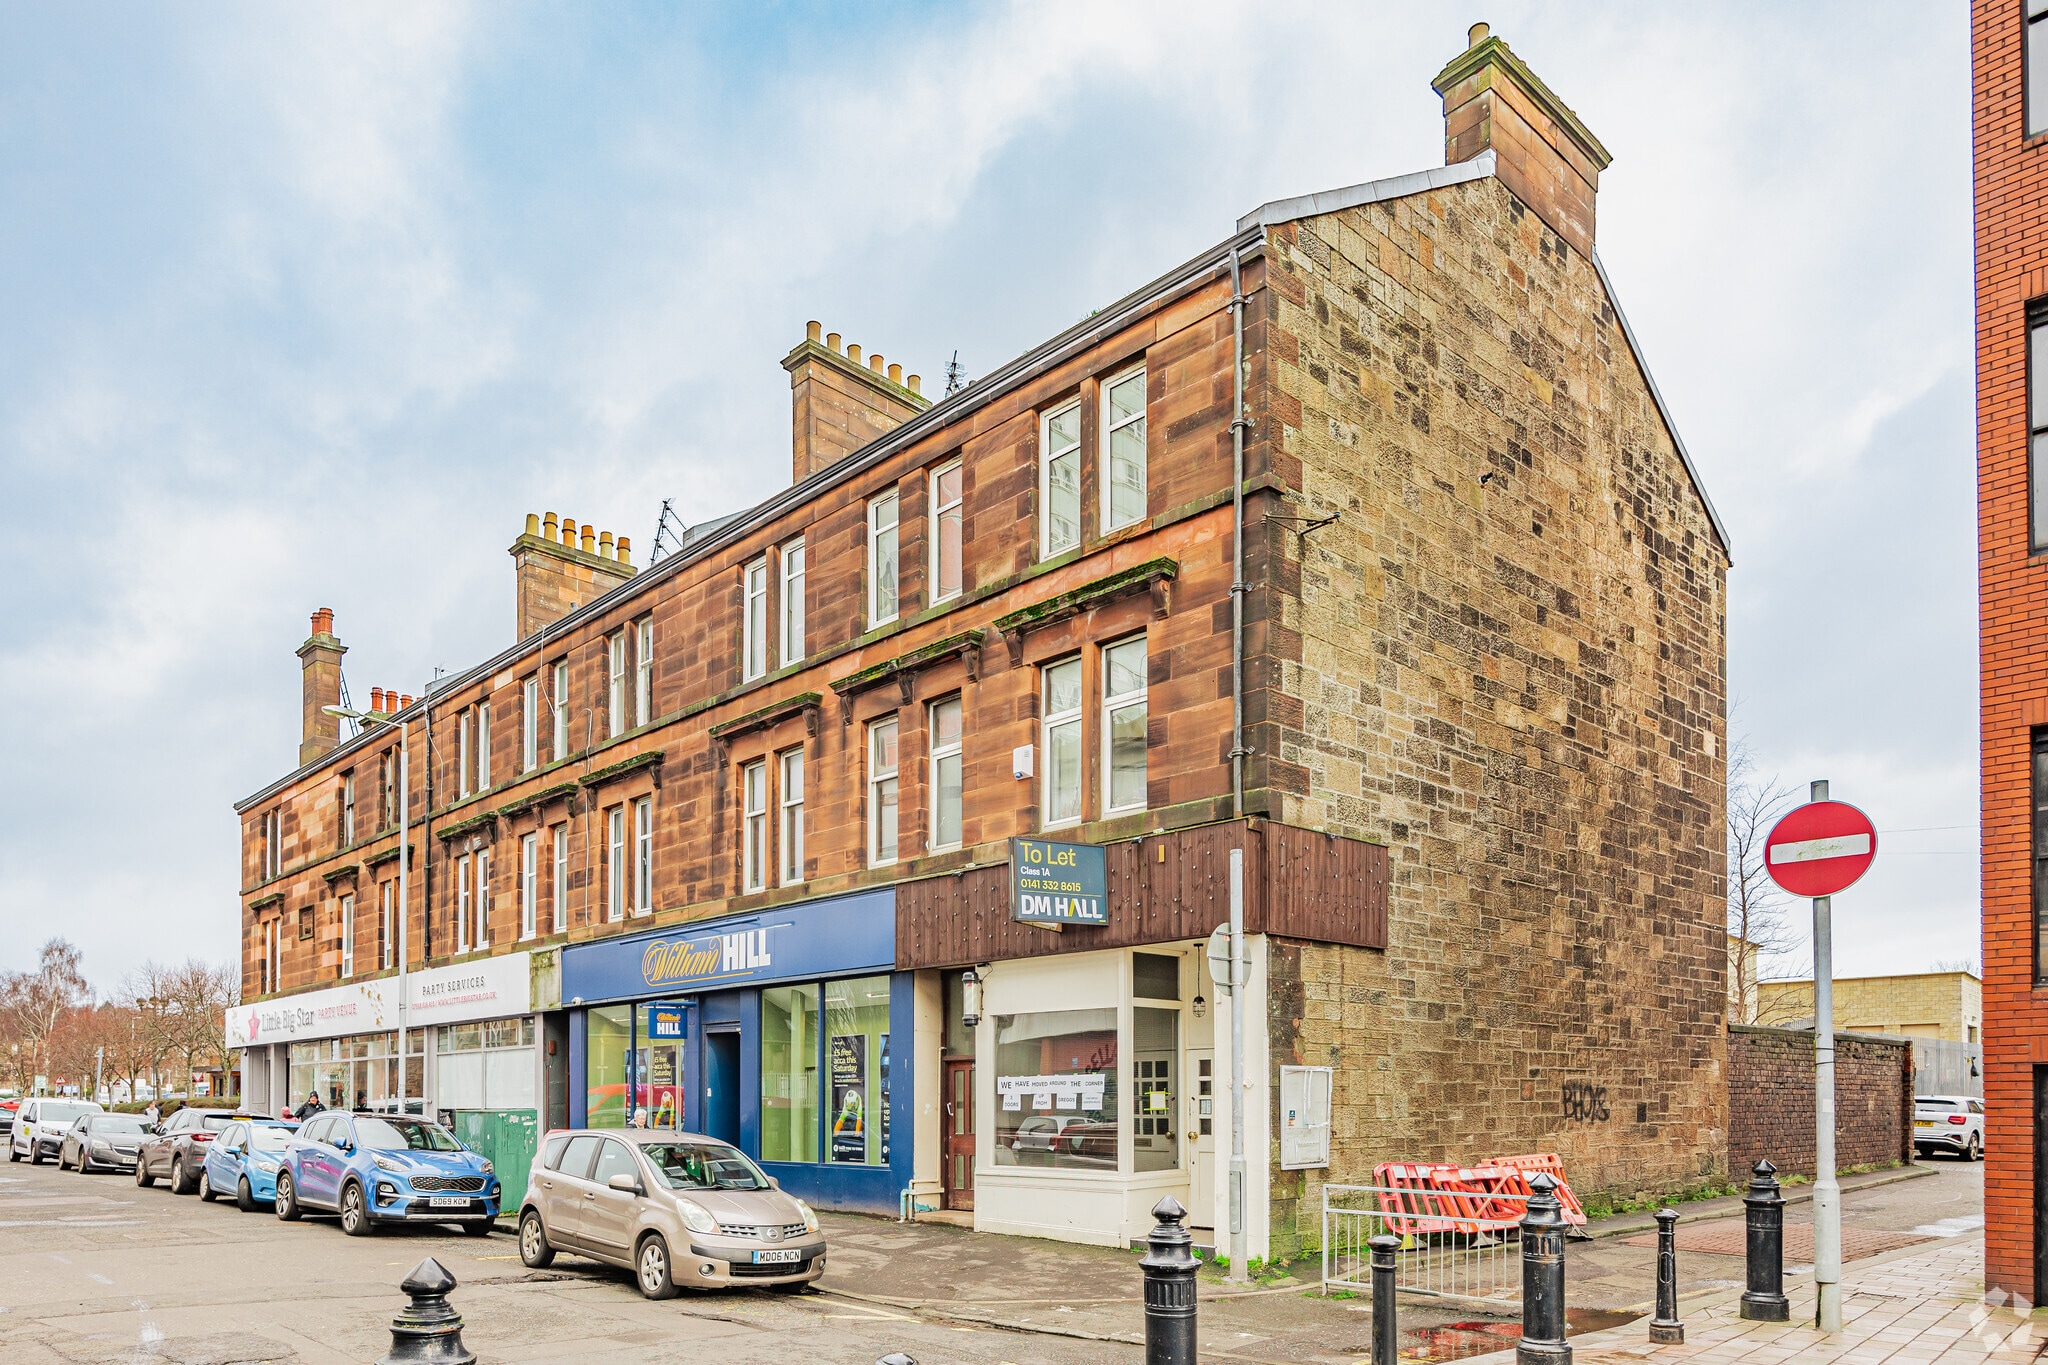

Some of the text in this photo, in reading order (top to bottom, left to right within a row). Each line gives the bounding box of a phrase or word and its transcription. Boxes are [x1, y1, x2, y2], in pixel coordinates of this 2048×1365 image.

[1020, 842, 1076, 867] To Let
[1020, 866, 1051, 877] Class 1A
[1020, 878, 1081, 892] 0141 332 8615
[1021, 894, 1103, 919] DM HALL
[642, 929, 771, 983] William HILL
[422, 976, 485, 996] PARTY SERVICES
[262, 1012, 282, 1032] Little
[282, 1010, 296, 1033] Big
[297, 1007, 315, 1027] Star
[337, 1003, 358, 1017] VENUE
[657, 1023, 681, 1034] HILL
[833, 1064, 858, 1073] Saturday
[1001, 1081, 1012, 1089] WE
[760, 1251, 800, 1261] MD06 NCN
